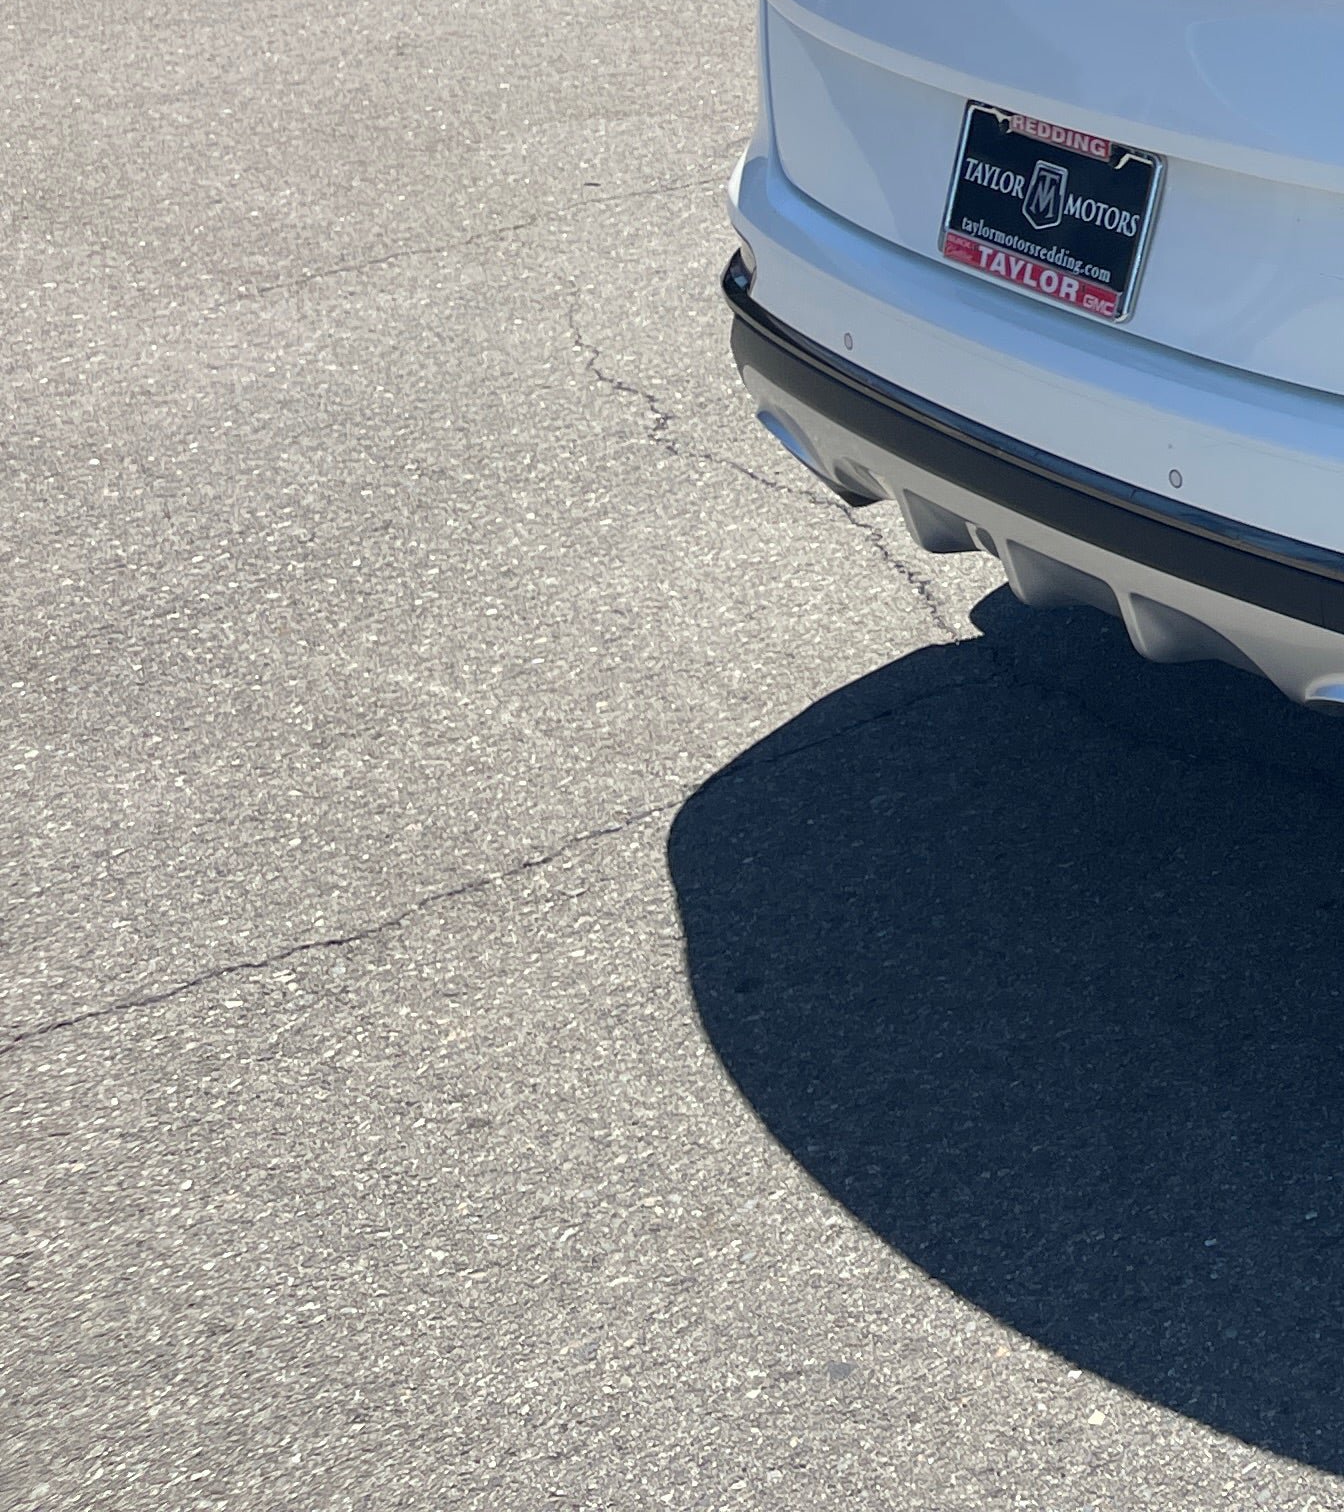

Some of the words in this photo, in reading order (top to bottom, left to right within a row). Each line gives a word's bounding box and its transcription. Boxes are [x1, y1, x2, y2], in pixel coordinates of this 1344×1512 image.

[1012, 113, 1107, 158] REDDING
[963, 157, 1025, 200] TAYLOR
[1063, 193, 1141, 238] MOTORS
[961, 216, 1112, 284] taylormotorsredding.com
[977, 244, 1081, 303] TAYLOR
[1083, 294, 1117, 317] GMC
